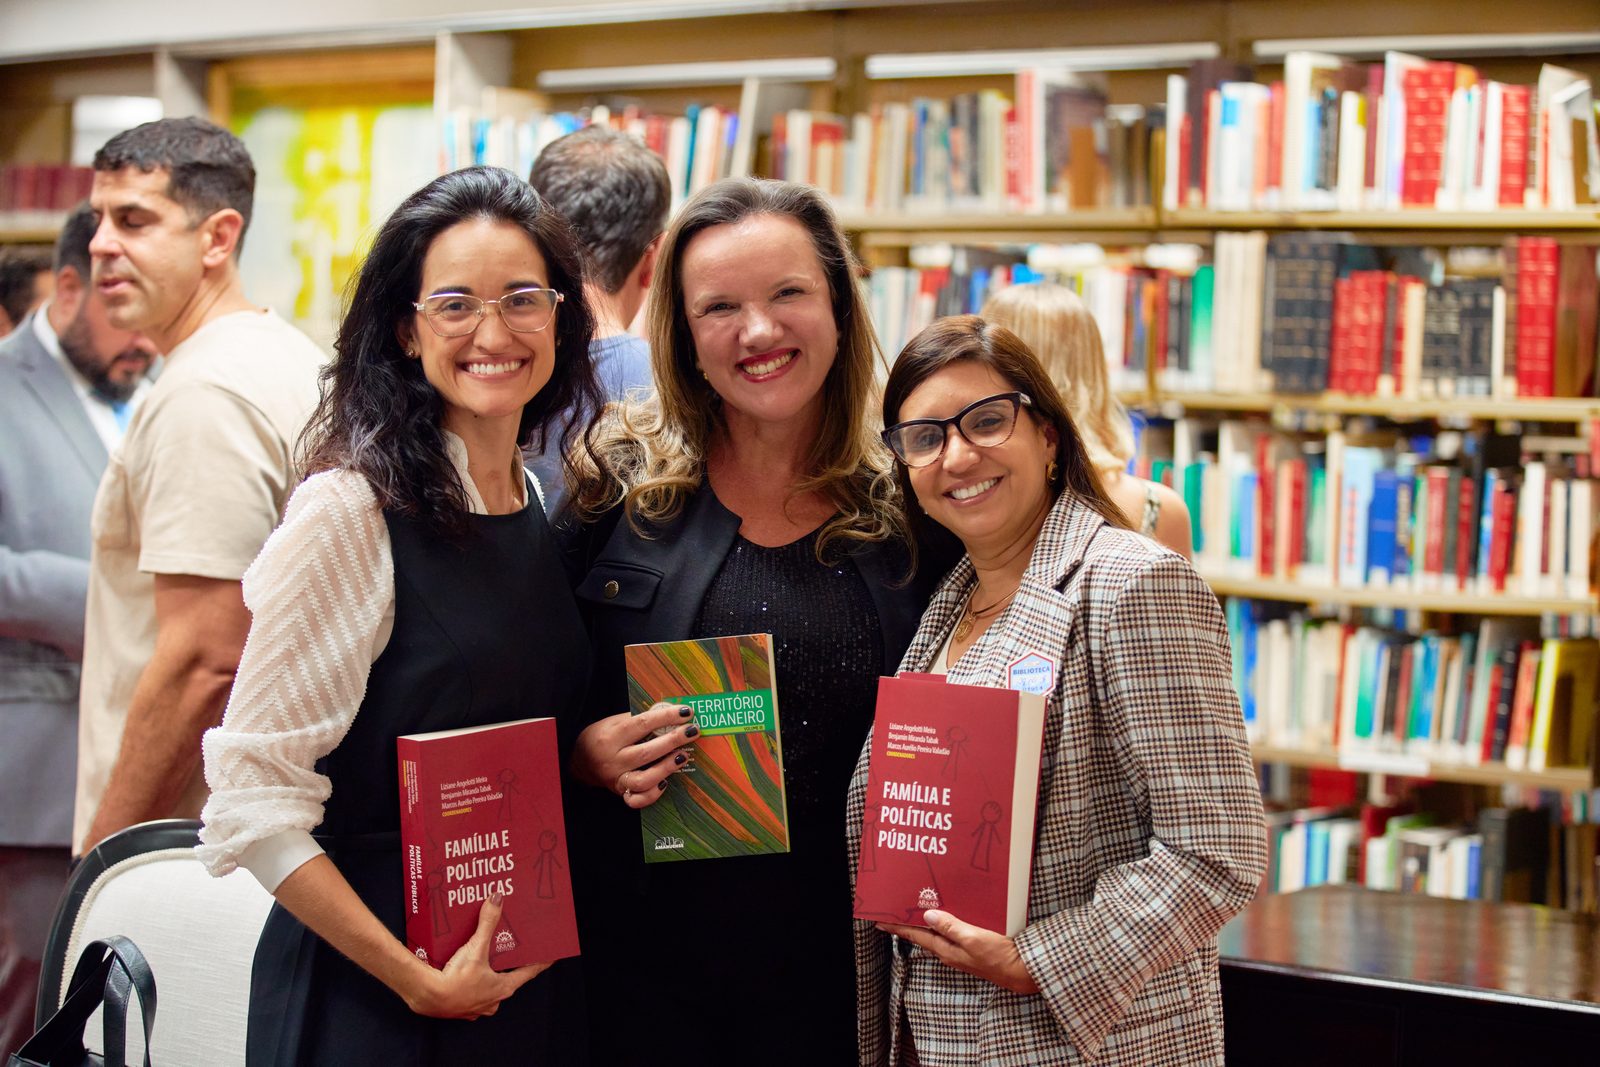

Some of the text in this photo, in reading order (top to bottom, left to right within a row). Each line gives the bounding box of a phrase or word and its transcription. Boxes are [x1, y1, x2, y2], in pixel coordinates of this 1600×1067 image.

[1013, 666, 1050, 675] BIBLIOTECA
[689, 694, 764, 713] TERRITÓRIO
[693, 710, 765, 728] ADUANEIRO
[887, 742, 902, 750] Marcos
[888, 732, 908, 741] Benjamin
[908, 734, 926, 743] Miranda
[441, 791, 462, 800] Benjamin
[462, 787, 479, 795] Miranda
[883, 780, 951, 806] FAMÍLIA E
[880, 805, 952, 831] POLÍTICAS
[444, 829, 510, 859] FAMÍLIA E
[878, 828, 948, 855] PÚBLICAS
[446, 853, 515, 883] POLÍTICAS
[448, 878, 514, 907] PÚBLICAS
